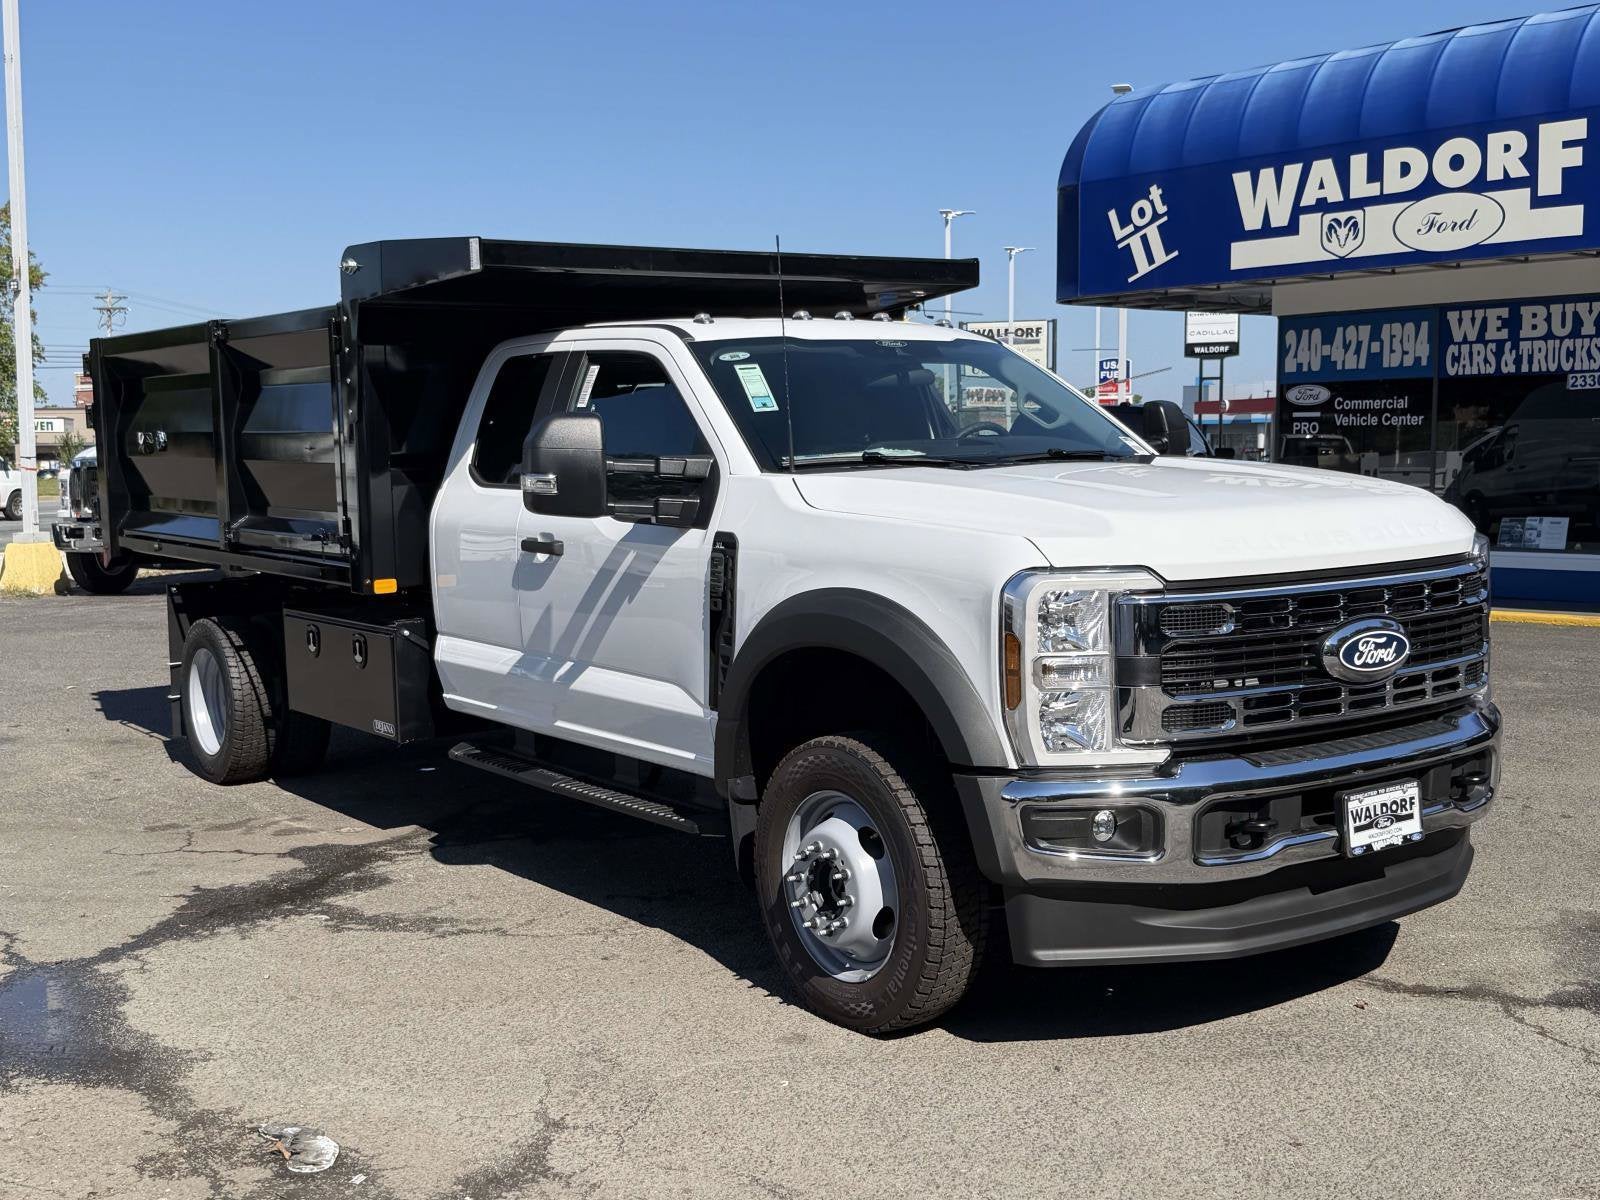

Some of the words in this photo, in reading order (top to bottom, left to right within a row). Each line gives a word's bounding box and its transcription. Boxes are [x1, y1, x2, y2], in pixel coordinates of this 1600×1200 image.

[1232, 118, 1588, 231] WALDORF
[1107, 184, 1169, 242] Lot
[1416, 210, 1480, 237] Ford
[1446, 307, 1509, 342] WE
[1520, 302, 1600, 338] BUY
[1284, 321, 1430, 373] 240-427-1394
[1446, 343, 1496, 376] CARS
[1500, 345, 1516, 373] &
[1519, 338, 1600, 373] TRUCKS
[1100, 371, 1119, 379] FUE
[1102, 361, 1119, 369] US
[1296, 388, 1320, 401] Ford
[1334, 396, 1408, 410] Commercial
[1293, 422, 1319, 434] PRO
[1334, 413, 1378, 426] Vehicle
[1382, 413, 1424, 426] Center
[1354, 636, 1397, 666] Ford
[1350, 796, 1416, 825] WALDORF
